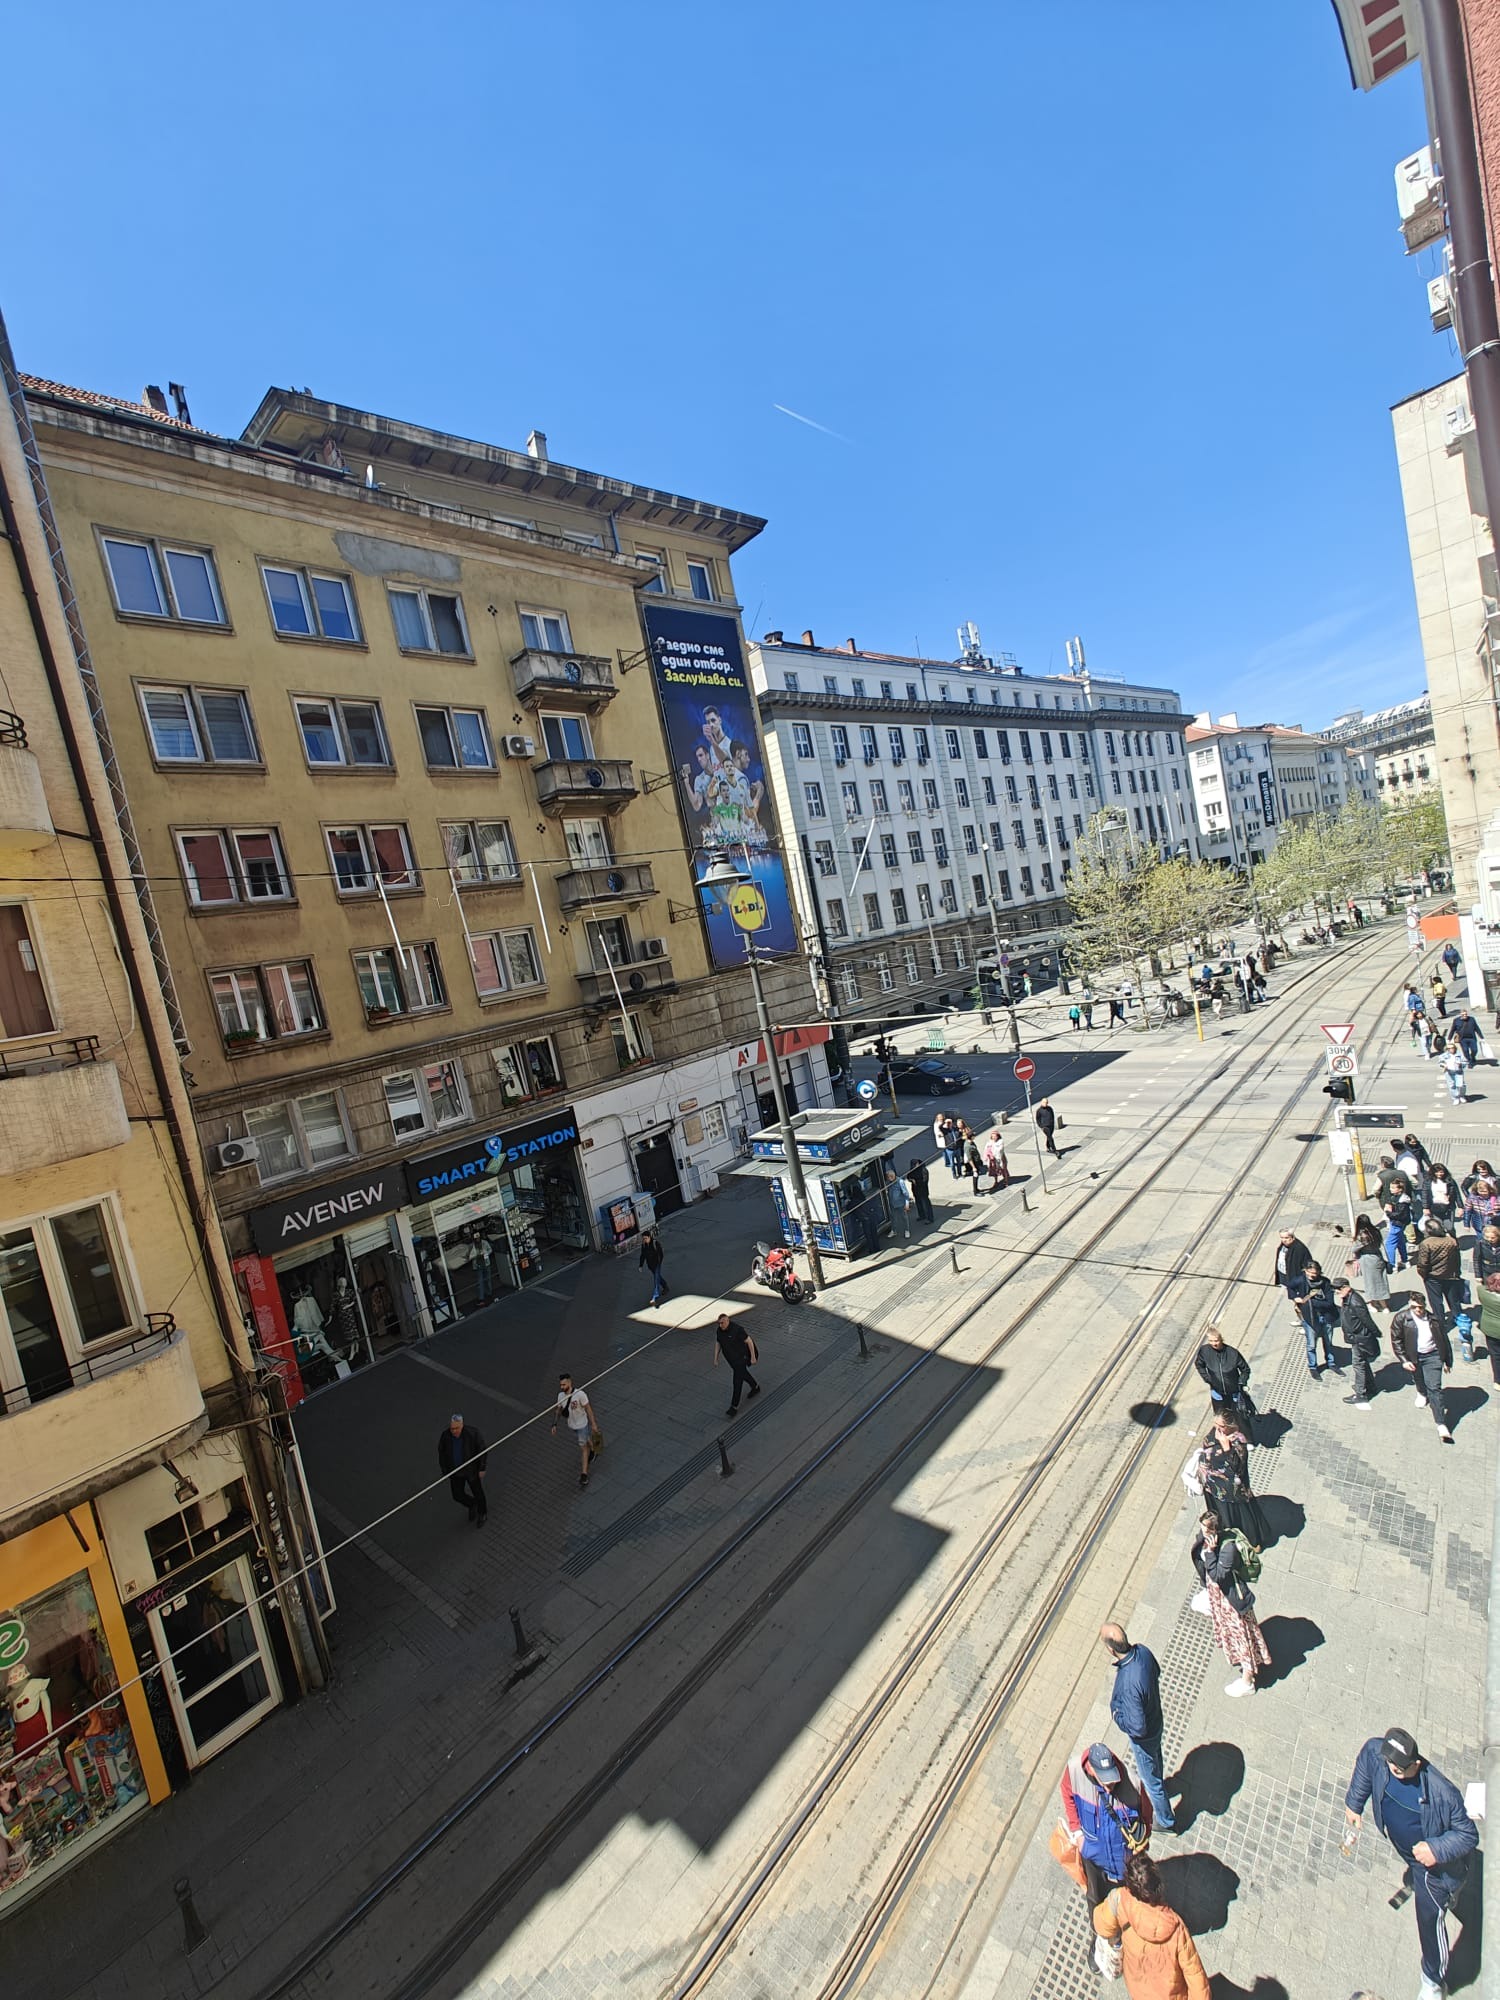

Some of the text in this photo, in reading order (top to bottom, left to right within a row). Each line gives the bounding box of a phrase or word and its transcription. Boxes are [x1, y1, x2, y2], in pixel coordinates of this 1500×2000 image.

[703, 644, 725, 657] сме
[661, 656, 734, 674] един отбор.
[663, 668, 744, 687] Заслужава си.
[738, 1047, 750, 1068] A1
[418, 1126, 576, 1196] SMART STATION
[280, 1182, 385, 1237] AVENEW
